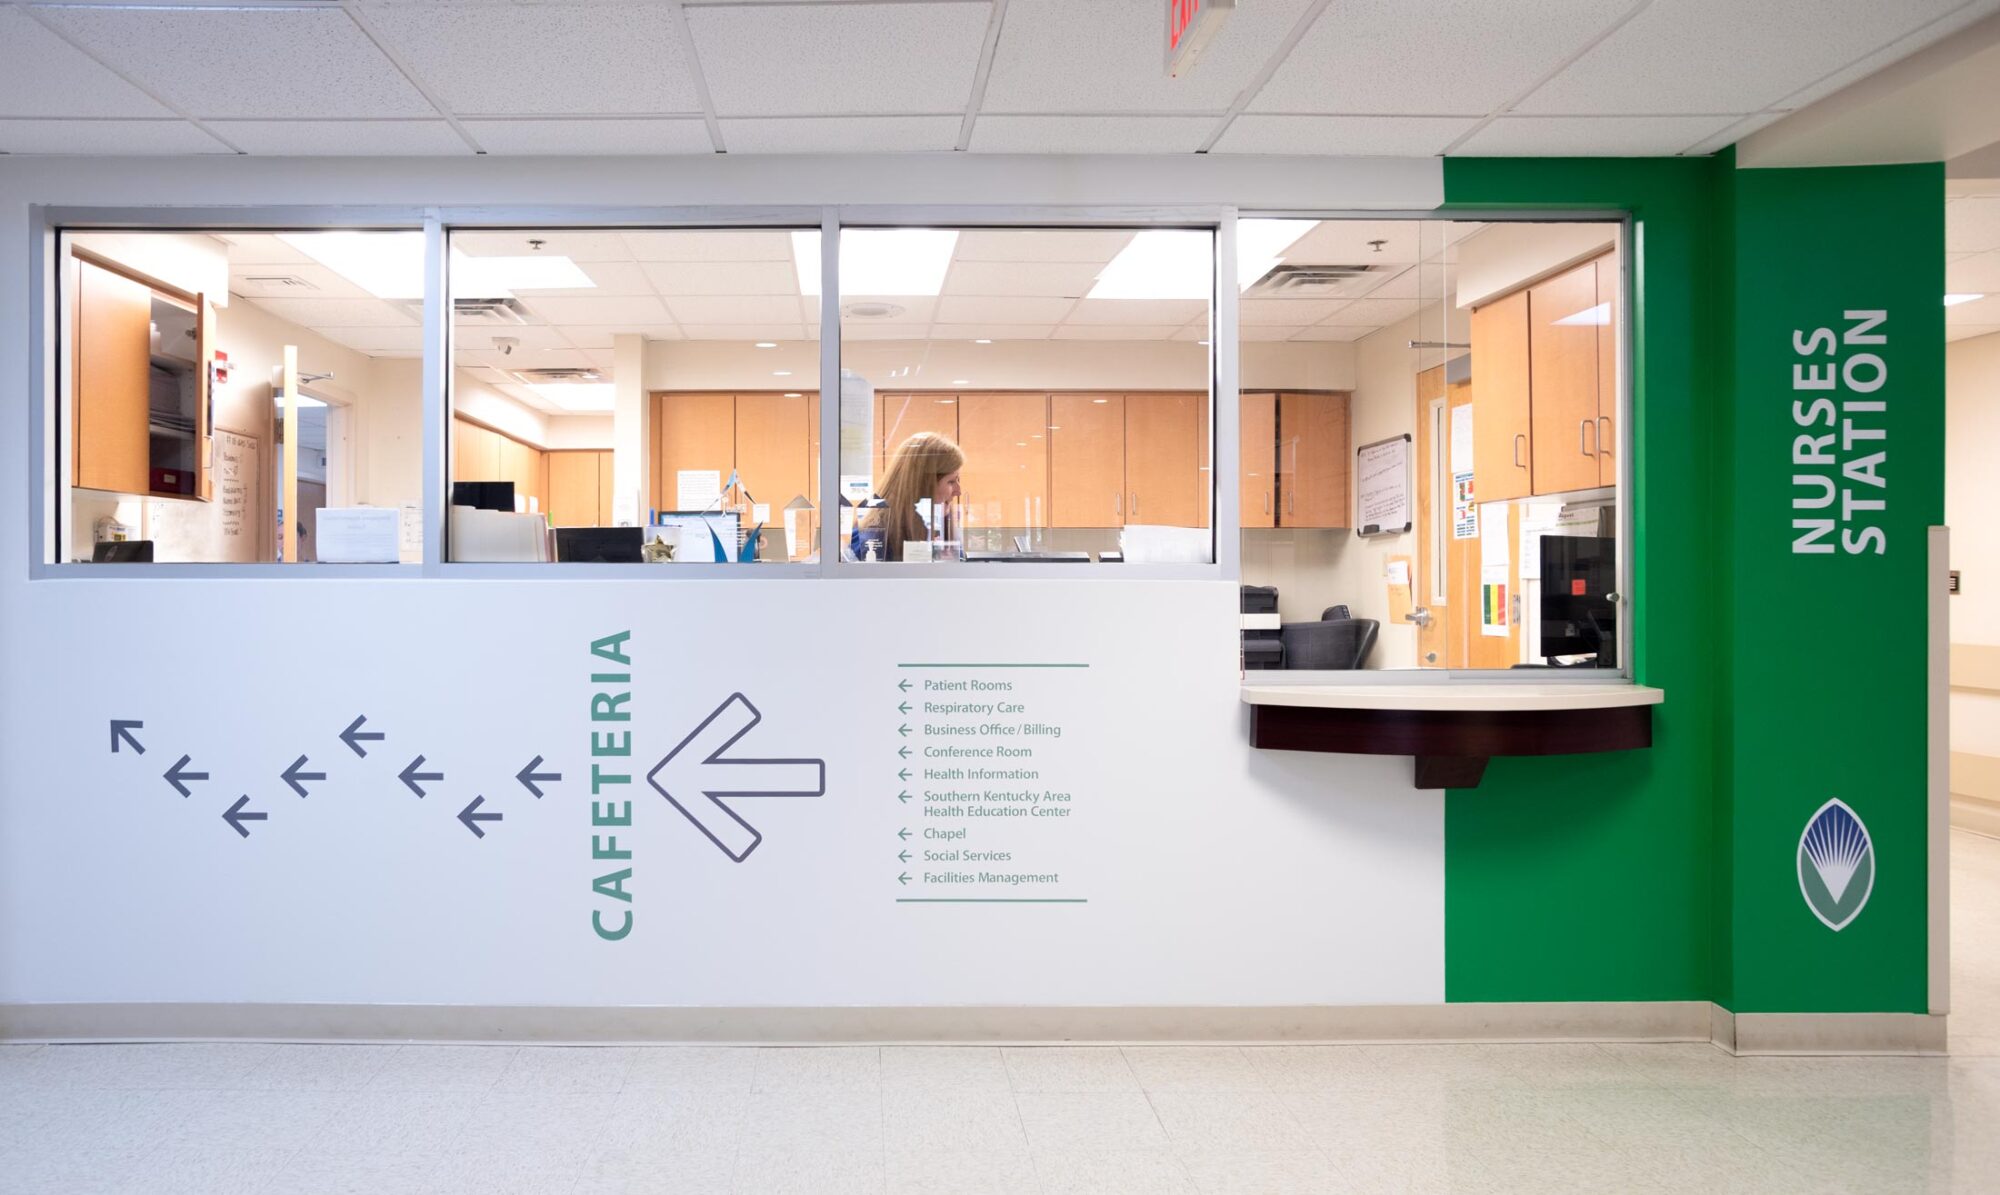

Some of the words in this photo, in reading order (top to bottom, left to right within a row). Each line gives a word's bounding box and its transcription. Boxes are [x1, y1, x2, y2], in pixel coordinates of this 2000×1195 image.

[1842, 309, 1888, 555] STATION
[1792, 327, 1837, 555] NURSES
[925, 680, 967, 691] Patient
[971, 680, 1012, 691] Rooms
[924, 702, 993, 716] Respiratory
[997, 702, 1024, 713] Care
[924, 724, 976, 735] Business
[924, 746, 993, 757] Conference
[997, 746, 1032, 757] Room
[924, 768, 964, 779] Health
[968, 768, 1038, 779] Information
[590, 629, 634, 942] CAFETERIA
[924, 790, 980, 802] Southern
[984, 790, 1039, 804] Kentucky
[1043, 791, 1071, 801] Area
[924, 806, 964, 817] Health
[968, 806, 1027, 816] Education
[1031, 806, 1071, 816] Center
[924, 828, 966, 842] Chapel
[924, 850, 959, 861] Social
[963, 850, 1011, 861] Services
[924, 872, 975, 883] Facilities
[979, 872, 1058, 885] Management
